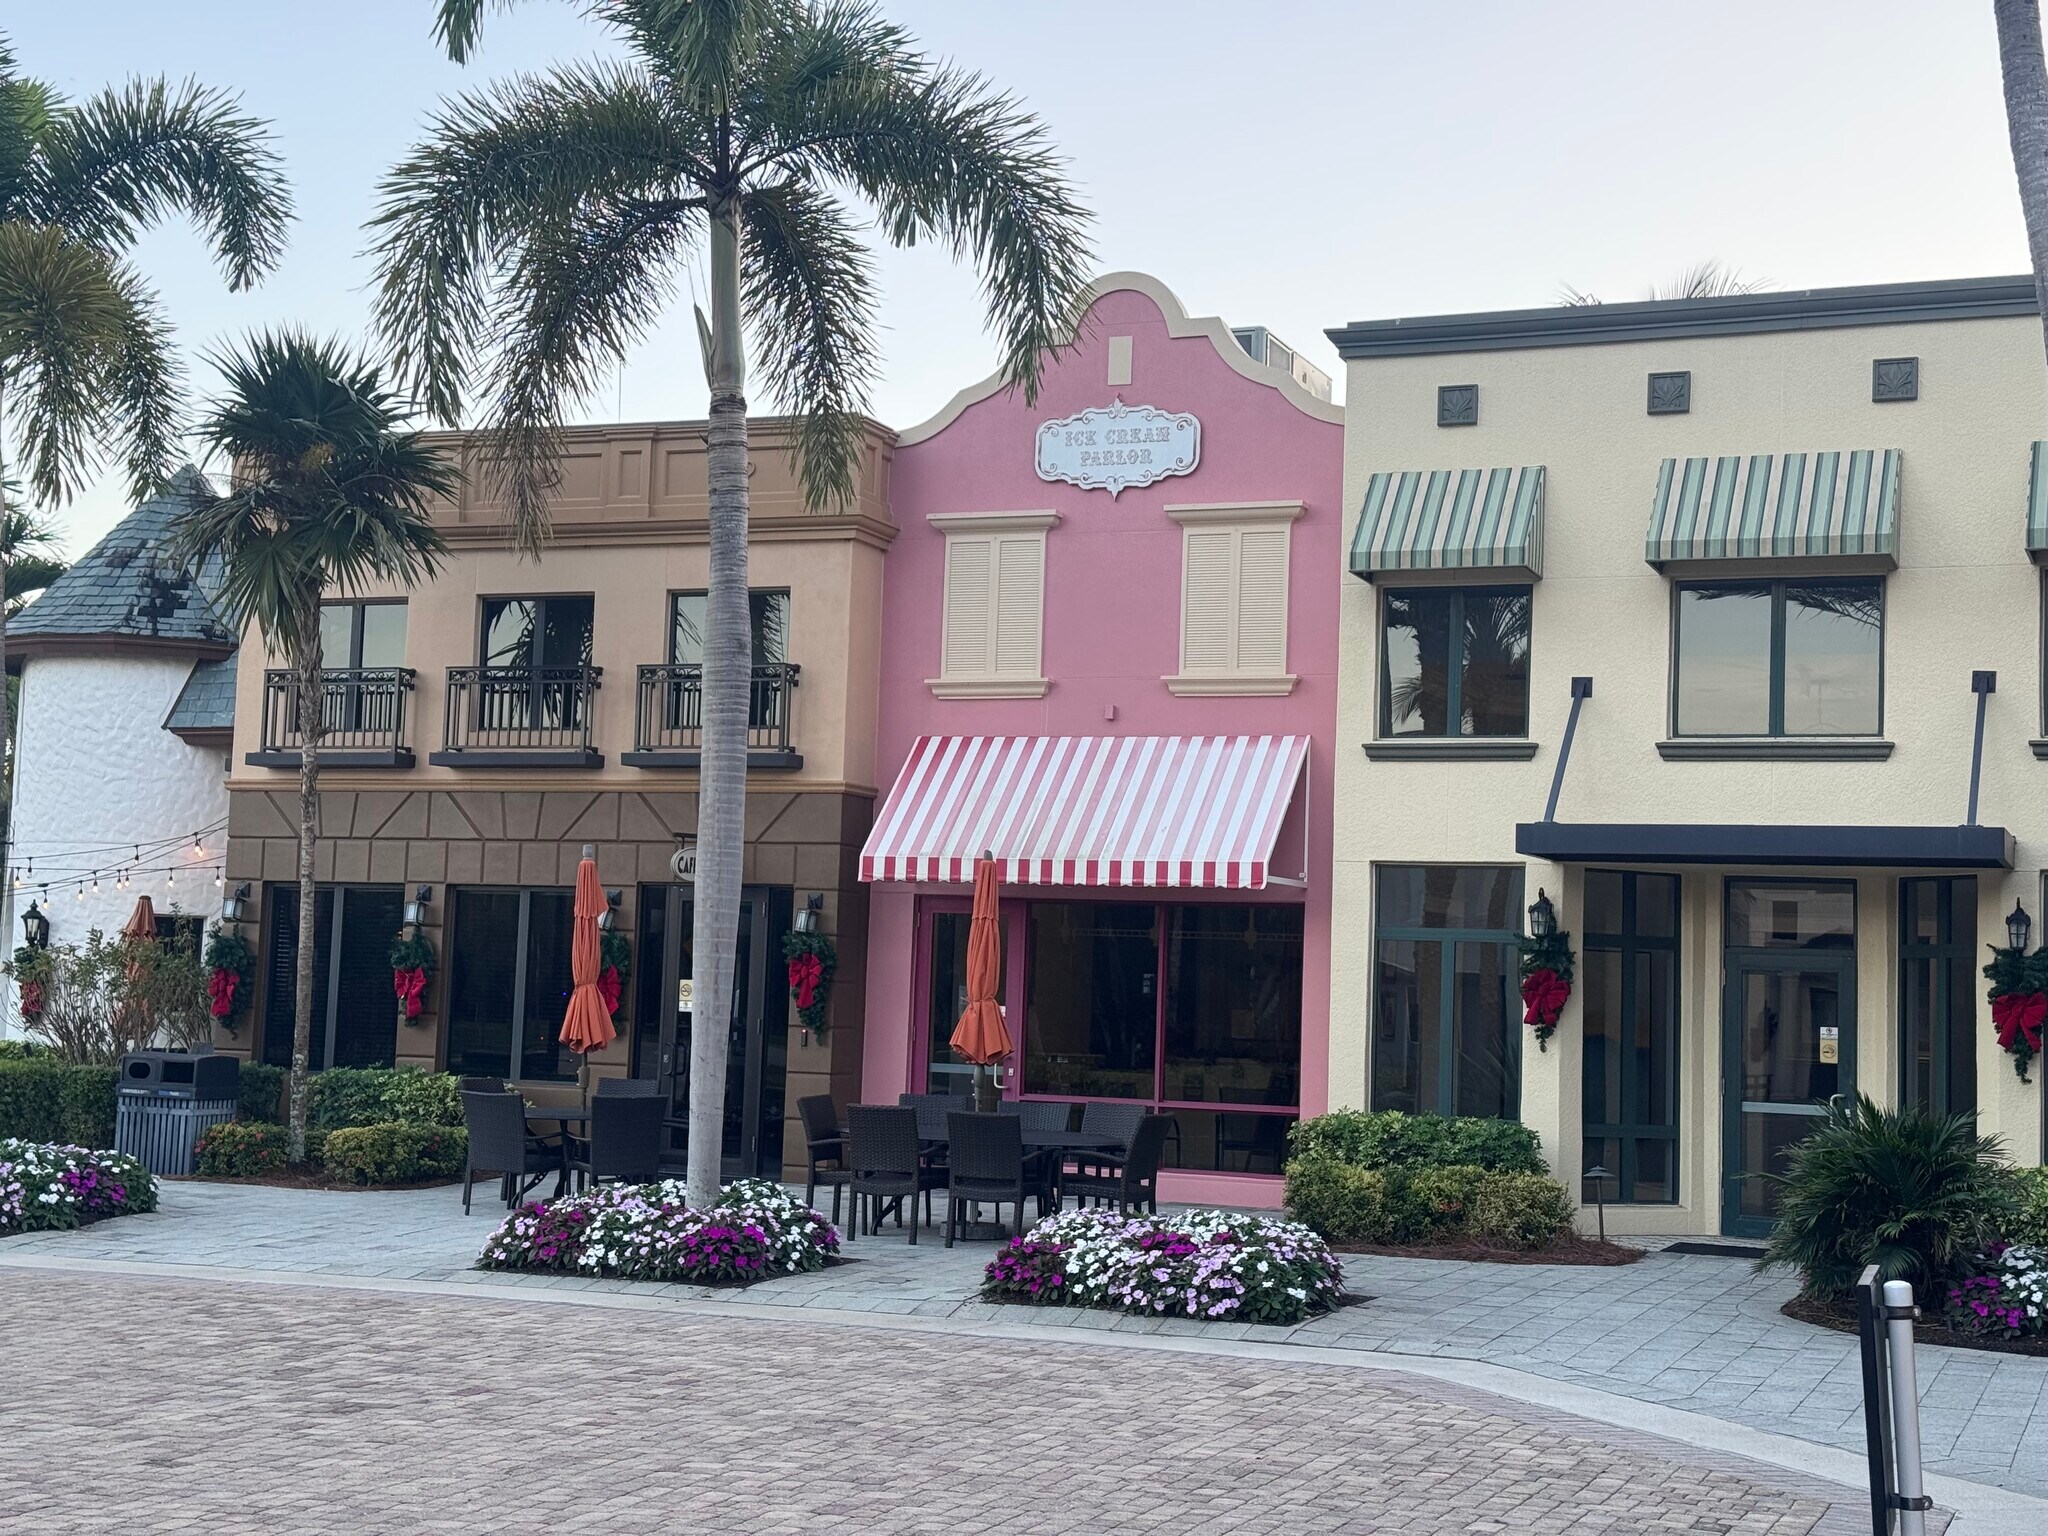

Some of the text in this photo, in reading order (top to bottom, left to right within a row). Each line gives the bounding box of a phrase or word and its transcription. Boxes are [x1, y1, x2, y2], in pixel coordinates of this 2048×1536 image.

[1065, 426, 1170, 447] ICE CREAM
[1080, 448, 1153, 467] PARLOR
